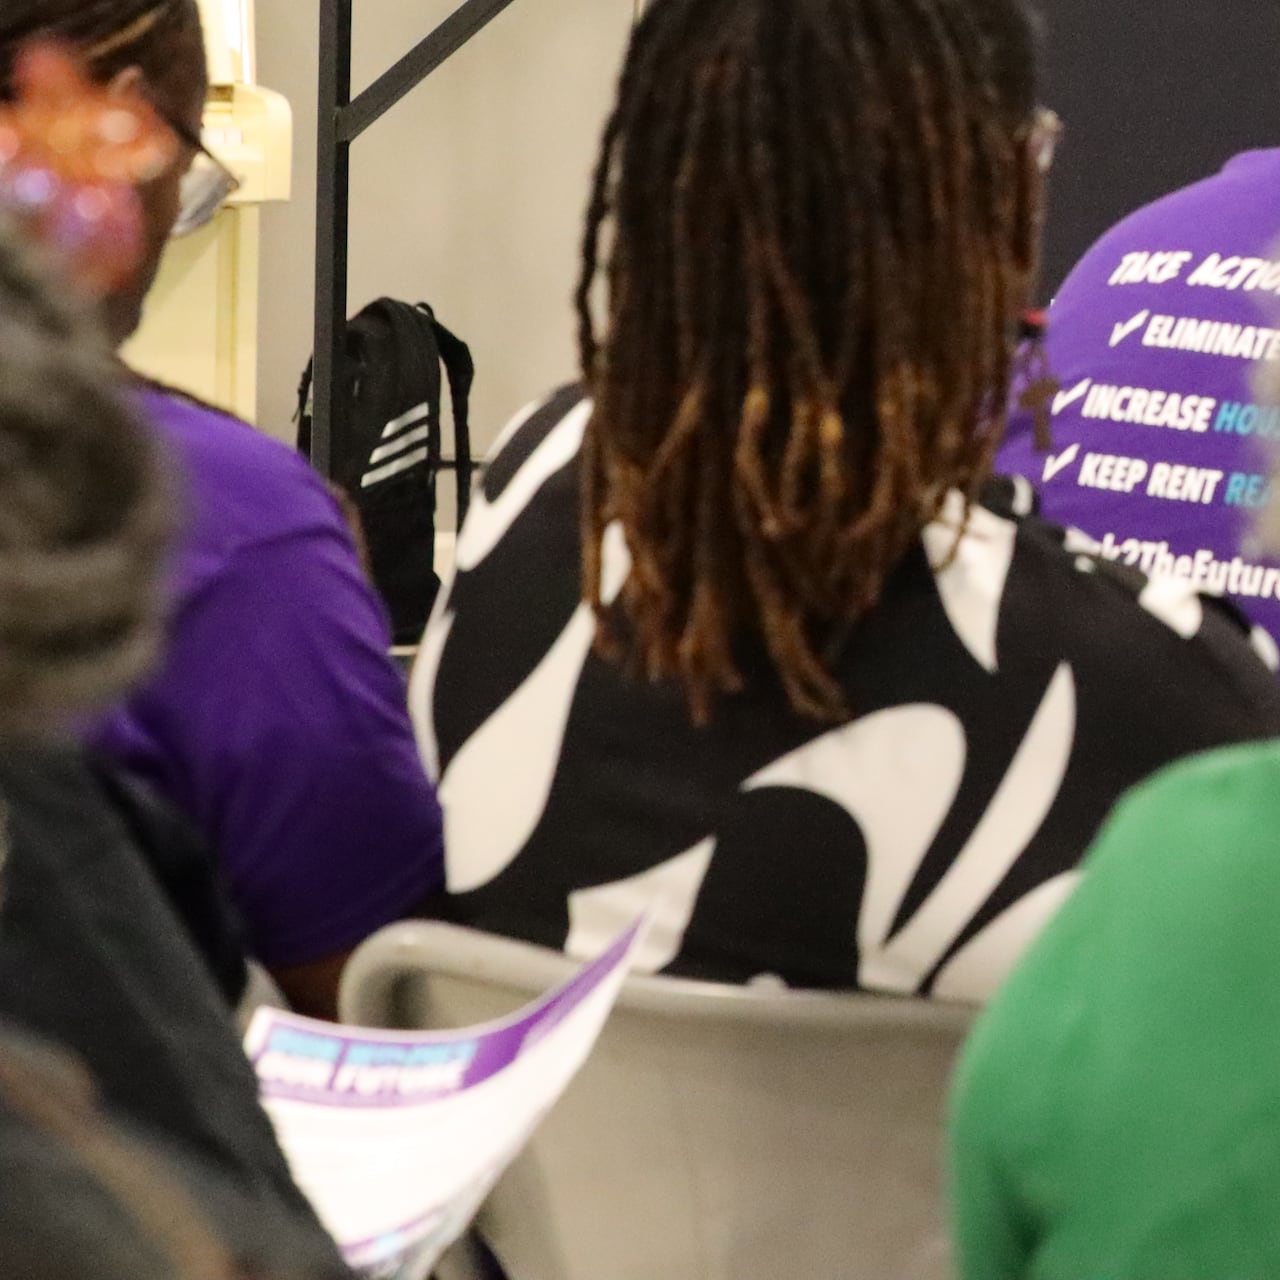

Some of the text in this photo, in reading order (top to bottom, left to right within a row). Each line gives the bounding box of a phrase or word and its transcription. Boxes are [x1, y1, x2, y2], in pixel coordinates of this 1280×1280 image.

[1108, 250, 1193, 286] TAKE
[1081, 383, 1217, 433] INCREASE
[1077, 452, 1148, 493] KEEP
[1146, 462, 1223, 505] RENT
